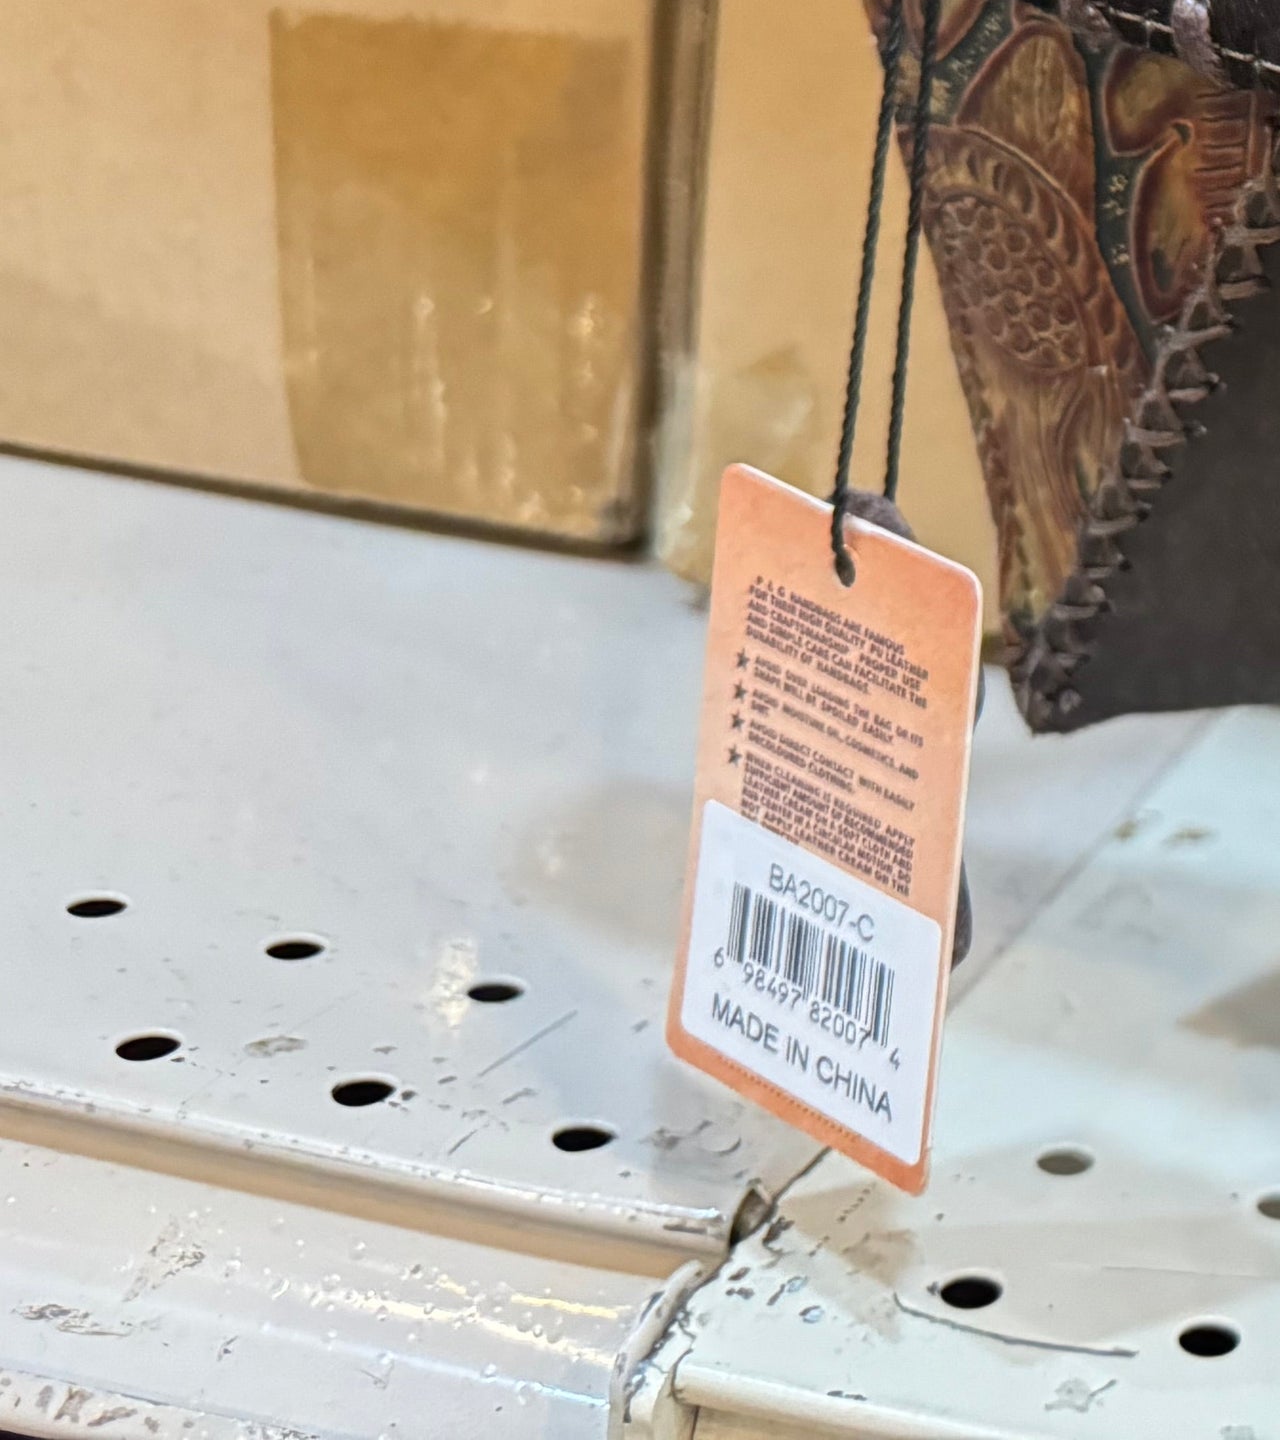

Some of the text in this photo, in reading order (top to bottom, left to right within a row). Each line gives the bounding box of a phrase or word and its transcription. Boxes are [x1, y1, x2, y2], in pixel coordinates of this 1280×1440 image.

[746, 624, 798, 659] DURABILITY
[747, 610, 926, 709] AND SIMPLE CARE CAN FACILITATE THE
[748, 598, 768, 617] AND
[859, 652, 897, 680] PROPER
[902, 672, 920, 692] USE
[749, 584, 767, 602] FOR
[769, 593, 796, 616] THEIR
[798, 608, 822, 629] HIGH
[824, 620, 865, 650] QUALITY
[885, 650, 928, 681] LEATHER
[790, 591, 841, 625] HANDBAGS
[842, 616, 861, 634] ARE
[864, 627, 904, 655] FAMOUS
[752, 687, 779, 708] AVOID
[782, 702, 824, 732] MOISTURE
[898, 761, 918, 781] AND
[753, 665, 781, 688] SHAPE
[783, 681, 803, 700] WILL
[820, 700, 858, 727] SPOILED
[755, 654, 782, 676] AVOID
[785, 669, 807, 689] OVER
[809, 682, 849, 710] LOADING
[854, 703, 869, 720] THE
[873, 714, 891, 731] BAG
[910, 731, 923, 747] ITS
[744, 762, 790, 794] SUFFICIENT
[792, 787, 829, 815] AMOUNT
[843, 814, 913, 860] RECOMMENDED
[746, 750, 771, 771] WHEN
[774, 765, 820, 797] CLEANING
[833, 796, 881, 830] REQUIRED
[885, 823, 915, 847] APPLY
[749, 719, 914, 812] AVOID DIRECT CONTACT WITH EASILY
[741, 797, 759, 815] NOT
[763, 809, 792, 832] APPLY
[793, 825, 835, 856] LEATHER
[837, 848, 872, 876] CREAM
[891, 878, 909, 897] THE
[742, 785, 758, 802] RUB
[759, 794, 791, 819] CENTER
[812, 822, 855, 854] CIRCULAR
[743, 773, 779, 800] LEATHER
[782, 793, 813, 818] CREAM
[837, 822, 859, 844] SOFT
[862, 836, 890, 860] CLOTH
[892, 852, 912, 872] AND
[770, 863, 875, 943] BA2007-C
[713, 947, 901, 1071] 6 98497 82007 4
[712, 993, 893, 1123] MADE IN CHINA
